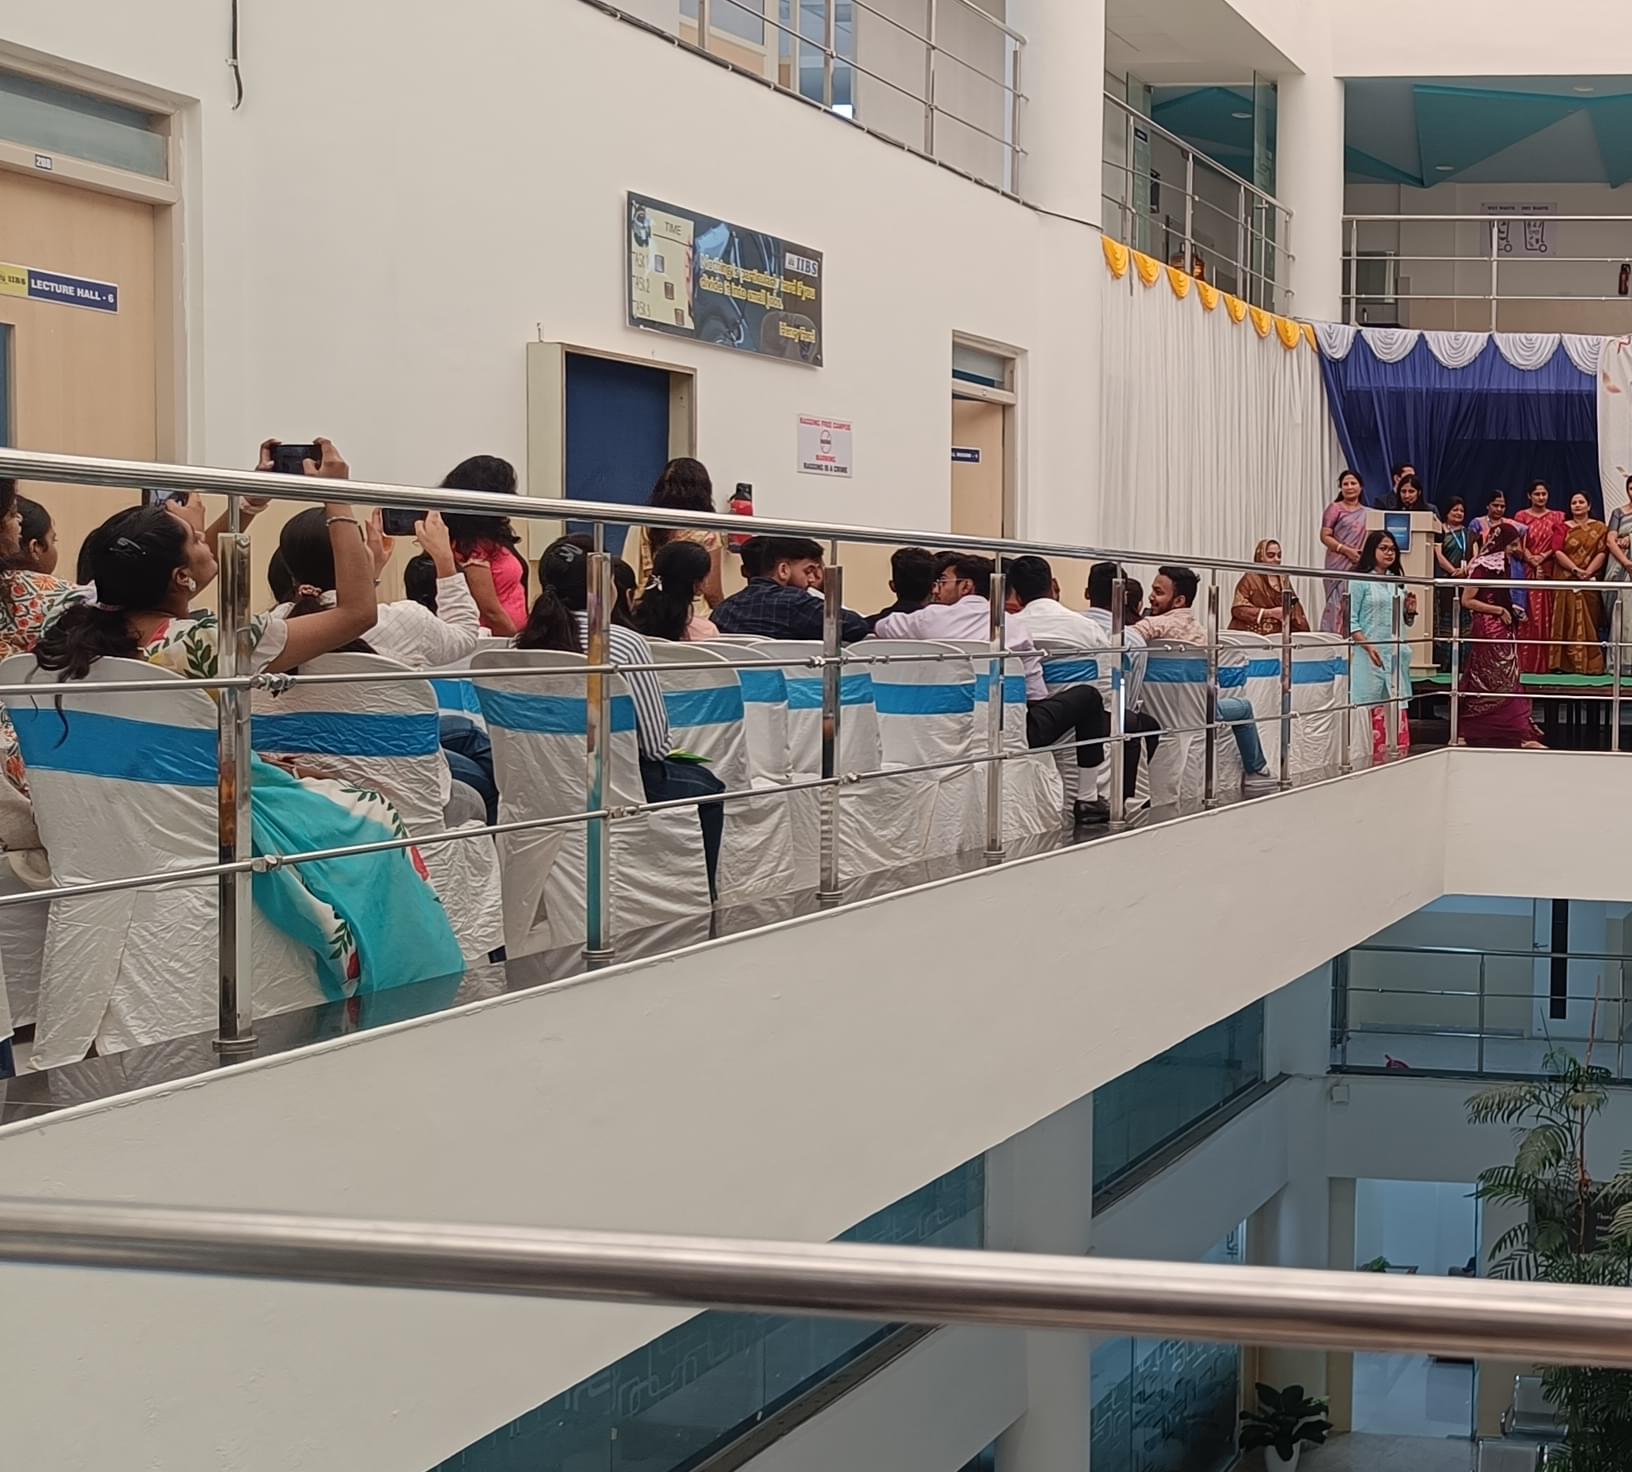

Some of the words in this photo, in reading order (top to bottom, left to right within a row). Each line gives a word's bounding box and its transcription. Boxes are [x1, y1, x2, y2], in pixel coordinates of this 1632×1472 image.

[665, 222, 681, 236] TIME
[797, 258, 817, 276] IIBS
[31, 279, 75, 296] LECTURE
[77, 288, 101, 301] HALL
[108, 294, 114, 303] 6
